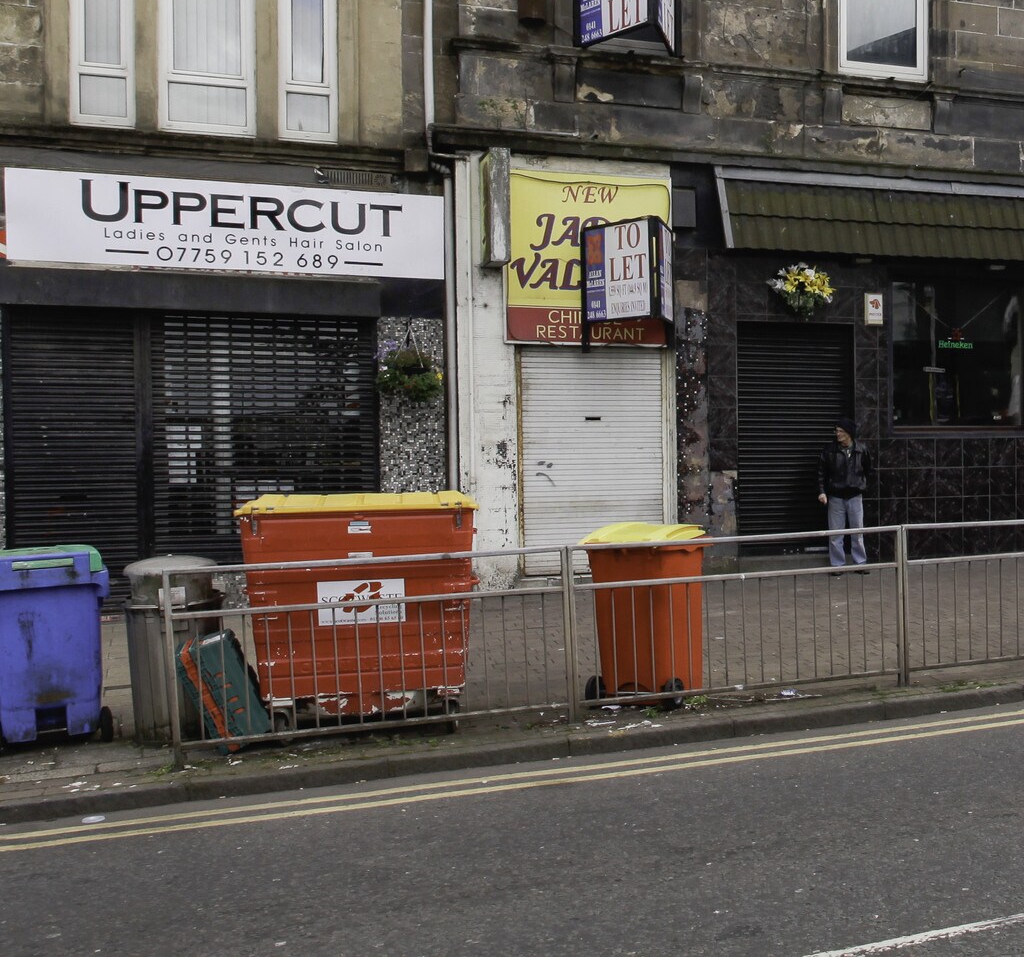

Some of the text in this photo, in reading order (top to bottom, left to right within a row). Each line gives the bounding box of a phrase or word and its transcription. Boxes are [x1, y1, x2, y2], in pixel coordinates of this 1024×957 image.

[561, 185, 619, 204] NEW
[79, 178, 403, 237] UPPERCUT
[104, 227, 383, 252] Ladies and Gents Hair Salon
[614, 222, 641, 250] TO
[156, 246, 339, 269] 07759 152 689
[609, 254, 647, 282] LET
[536, 325, 645, 340] RESTURANT
[938, 340, 973, 349] Heineken
